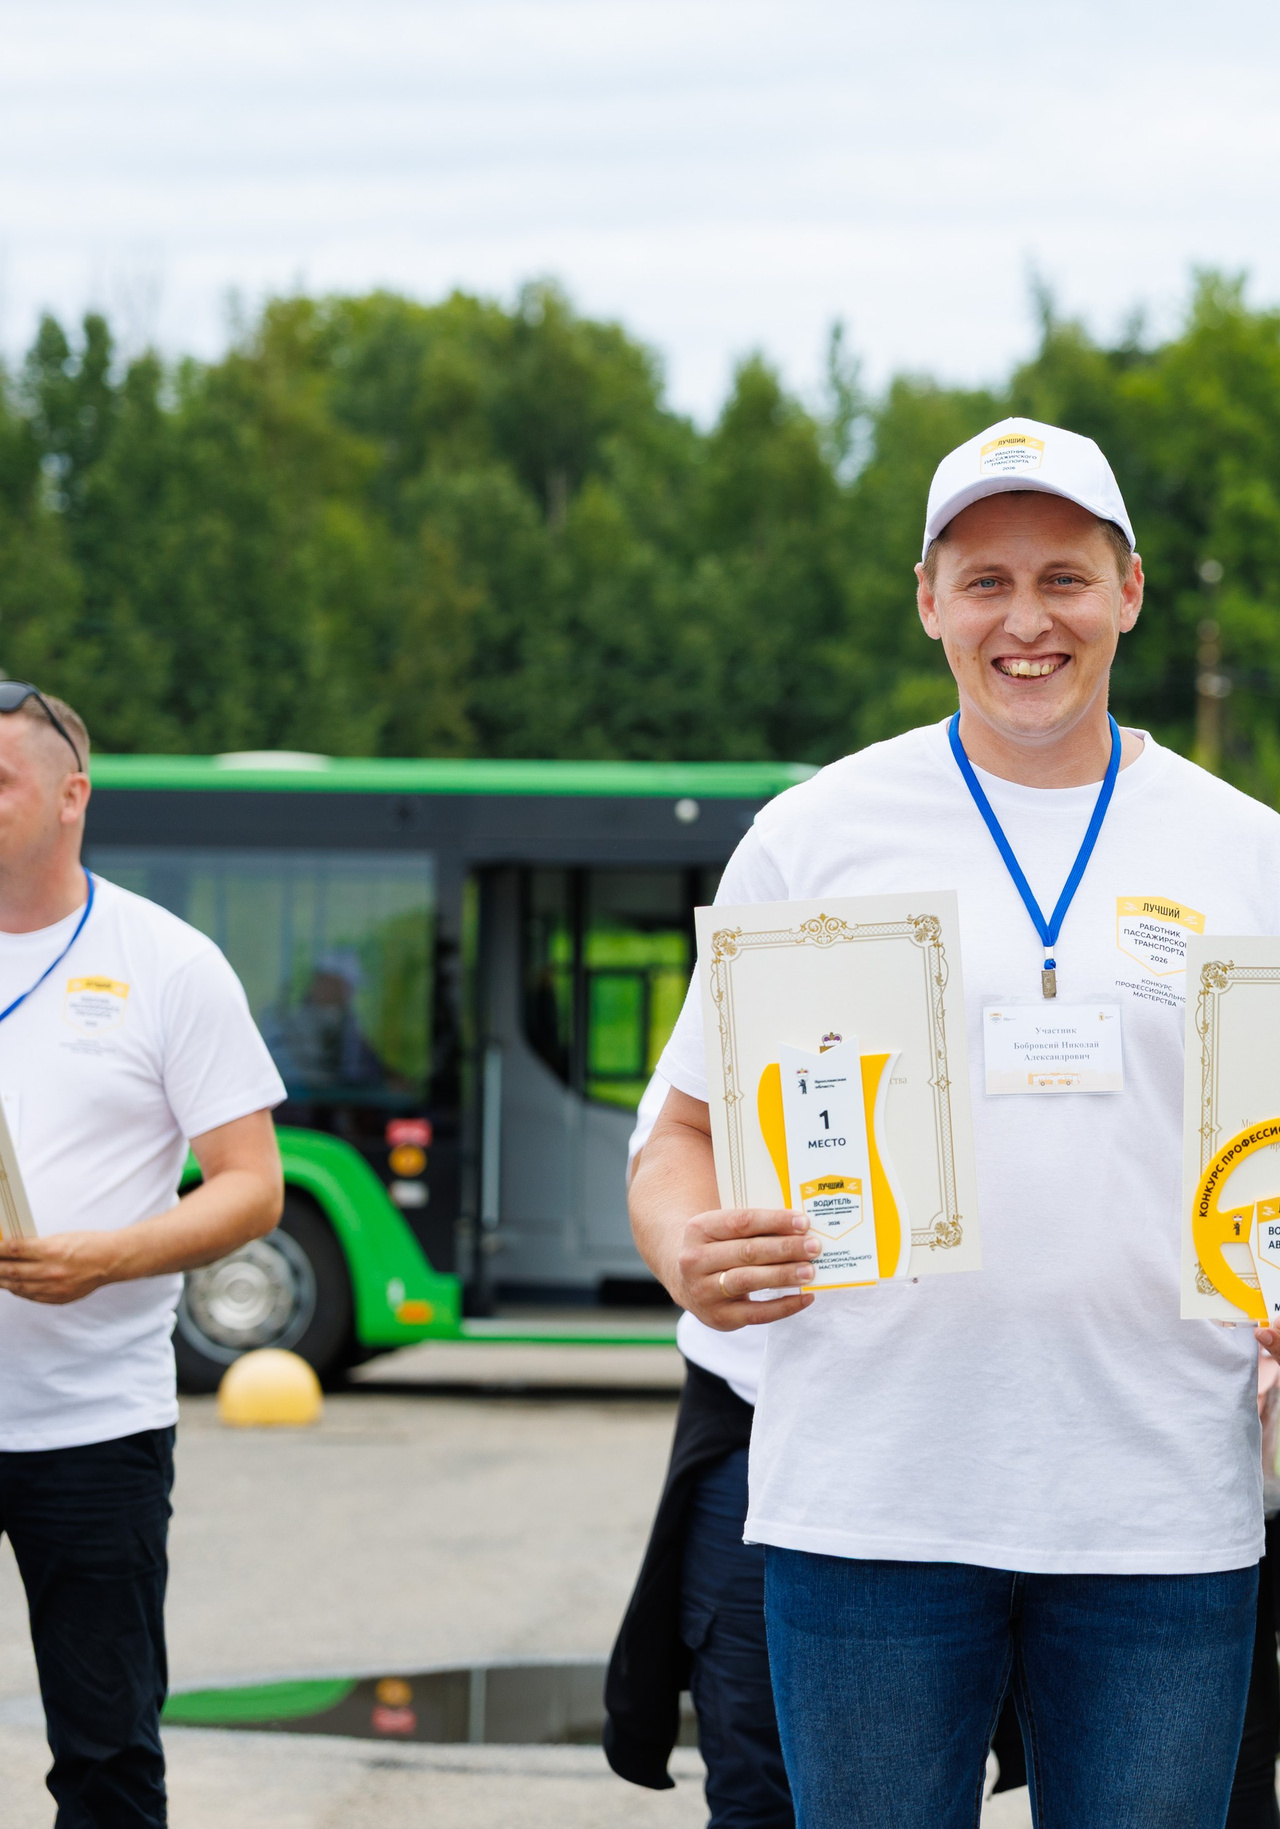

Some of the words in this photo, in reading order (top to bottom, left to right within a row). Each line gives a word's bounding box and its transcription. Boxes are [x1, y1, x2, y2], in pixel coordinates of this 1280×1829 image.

[997, 437, 1026, 446] ЛУЧШИЙ
[1142, 903, 1181, 919] ЛУЧШИЙ
[1139, 923, 1181, 938] РАБОТНИК
[1123, 928, 1187, 948] ПАССАЖИРСКО
[1134, 939, 1185, 957] ТРАНСПОРТА
[1150, 954, 1168, 964] 2026
[1141, 979, 1173, 991] КОНКУРС
[1115, 980, 1187, 1003] ПРОФЕССИОНАЛЬНО
[1133, 991, 1177, 1007] МАСТЕРСТВА
[1035, 1027, 1077, 1035] Участник
[1061, 1040, 1099, 1049] Николай
[1024, 1054, 1090, 1062] Александрович
[819, 1110, 830, 1130] 1
[808, 1137, 847, 1149] МЕСТО
[818, 1180, 845, 1191] ЛУЧШИЙ
[1199, 1163, 1225, 1217] КОНКУРС
[813, 1198, 852, 1208] ВОДИТЕЛЬ
[808, 1254, 872, 1265] ОФЕССИОНАЛЬНОГО
[818, 1262, 857, 1270] МАСТЕРСТВА
